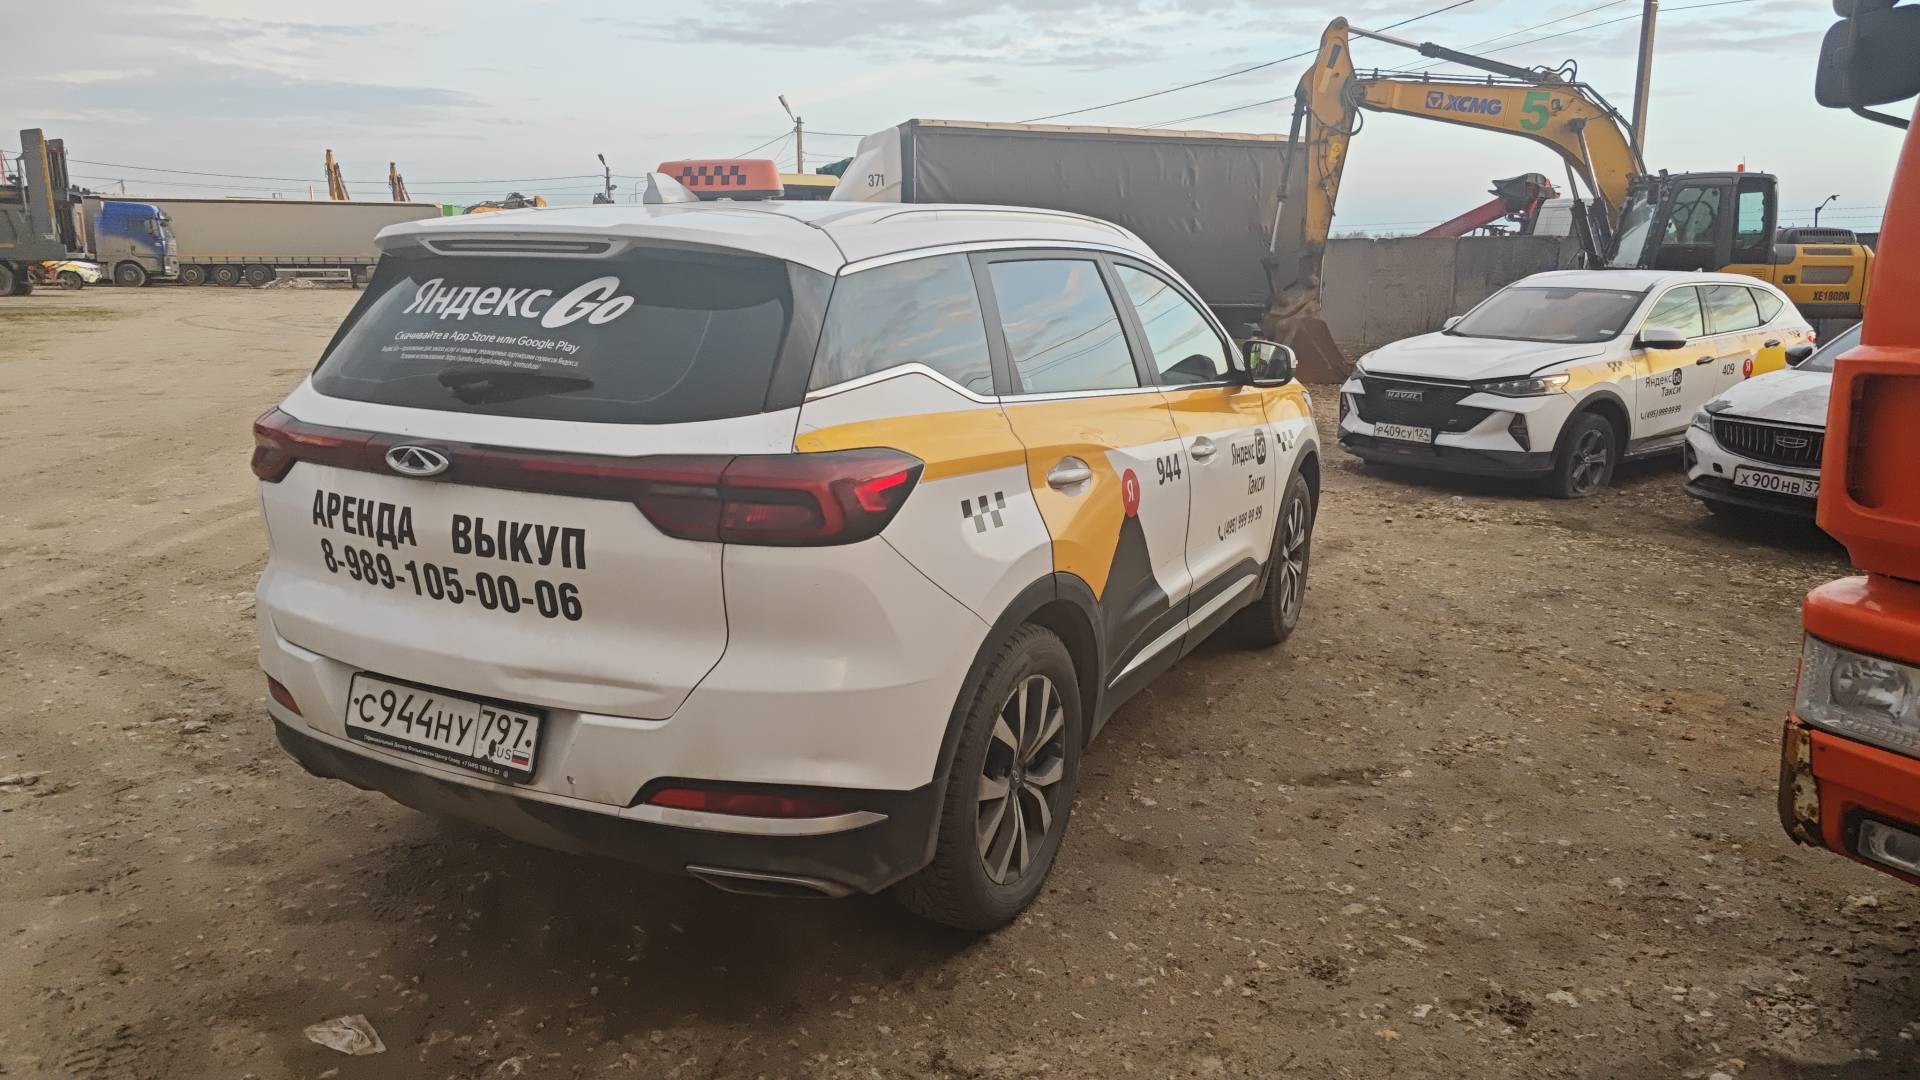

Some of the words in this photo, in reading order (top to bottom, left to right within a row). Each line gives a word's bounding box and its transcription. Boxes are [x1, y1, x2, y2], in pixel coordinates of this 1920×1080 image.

[1443, 95, 1502, 115] XCMG
[1519, 92, 1550, 131] 5
[868, 174, 885, 187] 371
[403, 278, 553, 320] Яндекс
[541, 276, 635, 328] Go
[394, 330, 443, 341] Скачивайте
[449, 331, 469, 343] App
[469, 332, 496, 344] Store
[496, 336, 517, 345] или
[517, 336, 555, 350] Google
[555, 340, 581, 355] Play
[1645, 375, 1673, 388] Яндекс
[1722, 363, 1735, 376] 409
[1661, 386, 1681, 397] Такси
[1231, 442, 1255, 467] Яндекс
[1157, 453, 1181, 485] 944
[1248, 474, 1265, 495] Такси
[312, 489, 417, 550] АРЕНДА
[452, 514, 586, 570] ВЫКУП
[321, 538, 583, 621] 8-989-105-00-06
[481, 709, 528, 749] 797
